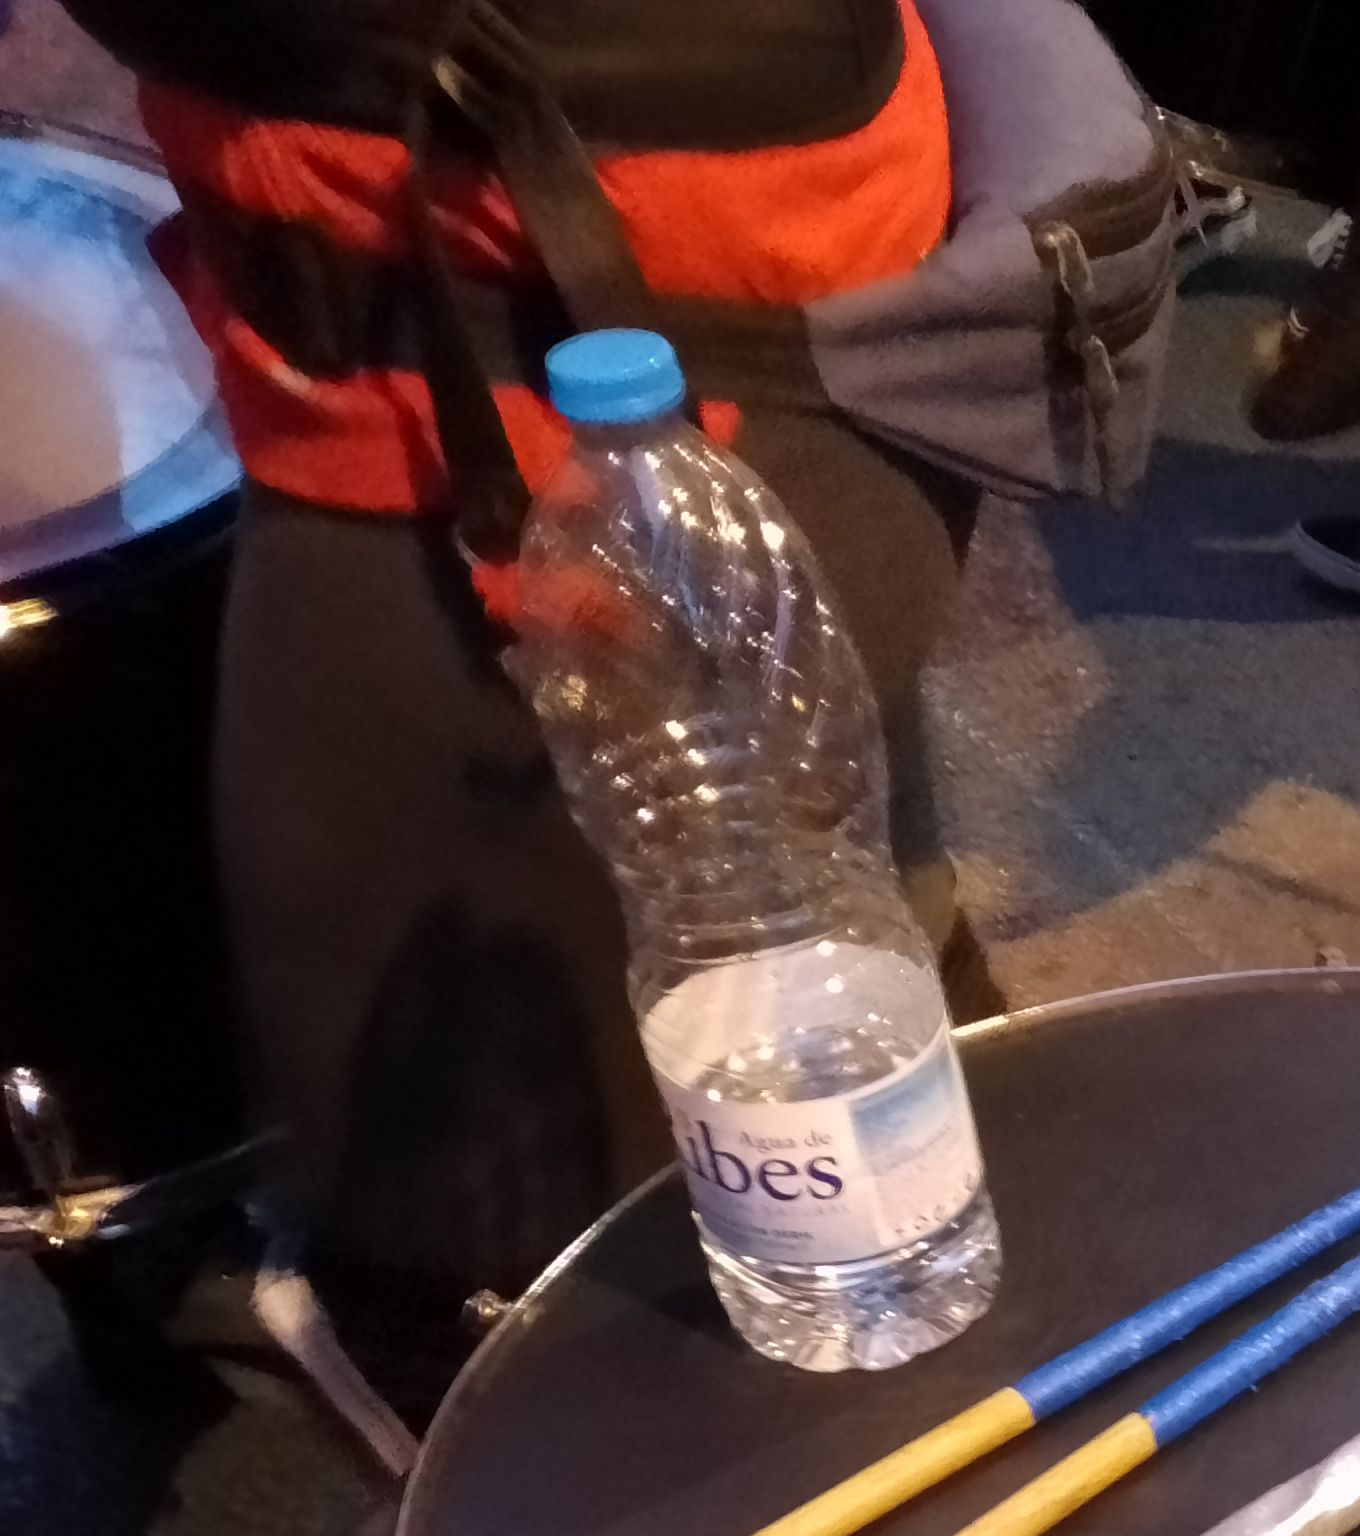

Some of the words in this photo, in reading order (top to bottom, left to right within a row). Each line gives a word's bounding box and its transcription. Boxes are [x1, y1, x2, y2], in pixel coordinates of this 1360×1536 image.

[686, 1119, 845, 1202] ibes
[739, 1129, 798, 1154] Agua
[803, 1128, 834, 1147] de
